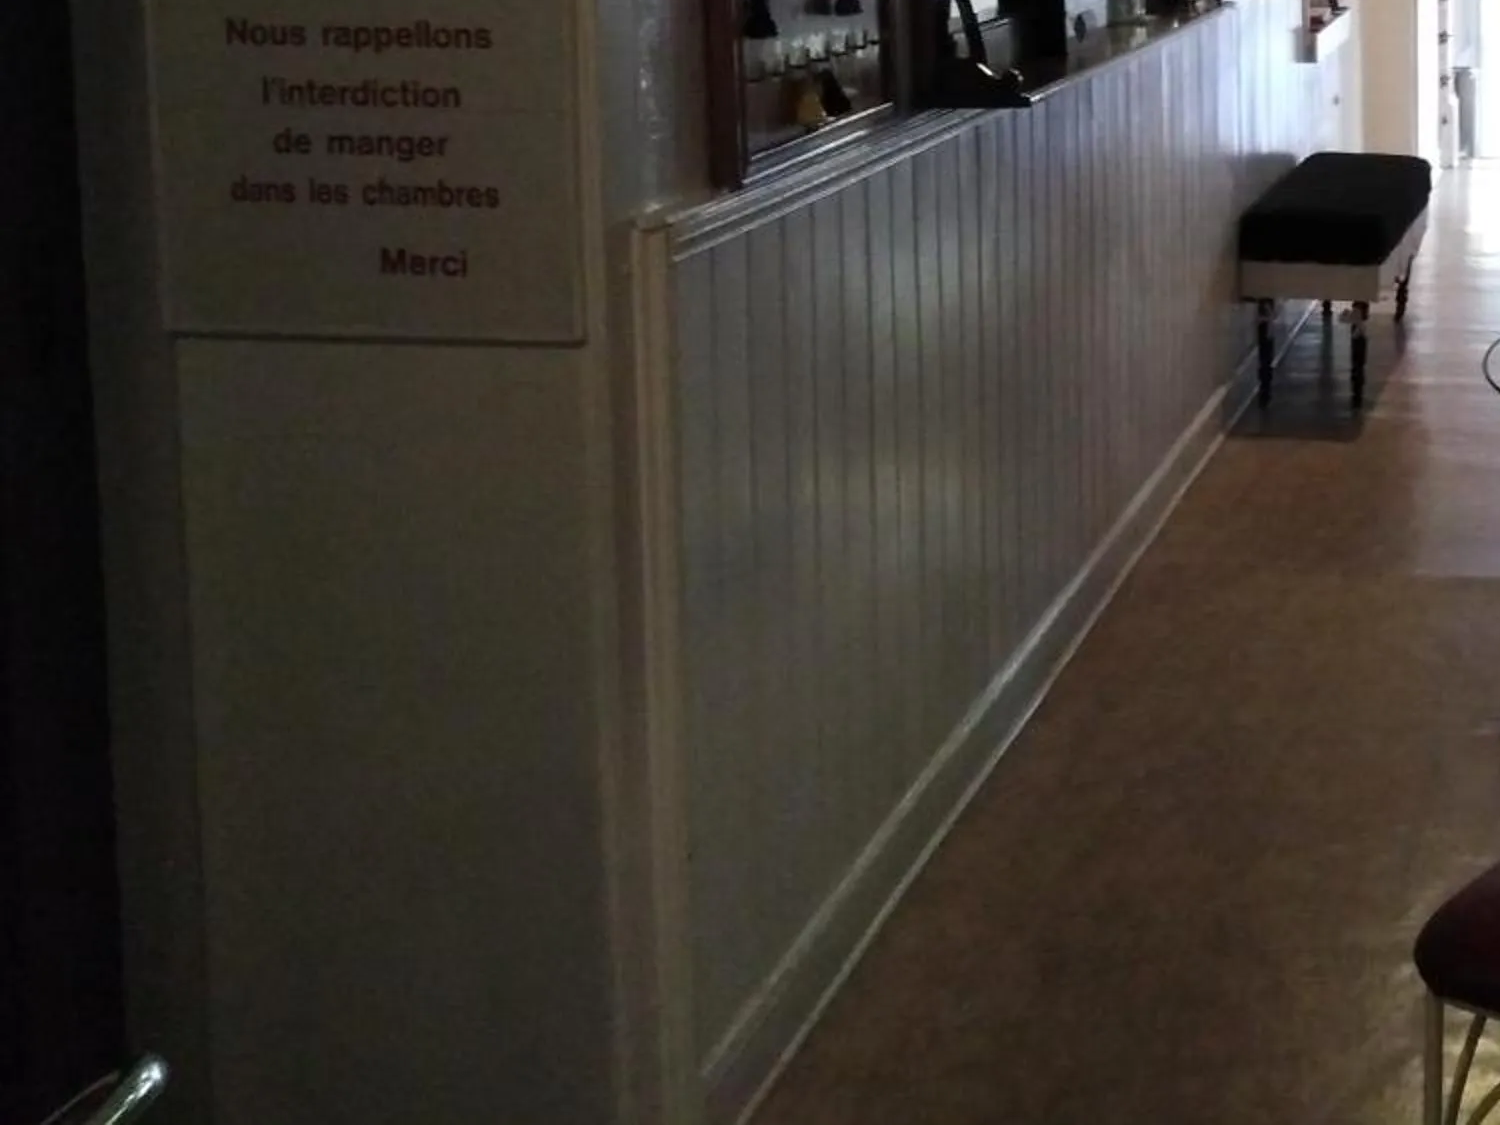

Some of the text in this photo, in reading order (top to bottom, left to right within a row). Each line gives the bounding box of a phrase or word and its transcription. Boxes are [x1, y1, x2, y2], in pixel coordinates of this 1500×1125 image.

[224, 16, 494, 55] Nous rappellons
[261, 75, 462, 109] l'interdiction
[271, 126, 449, 163] de manger
[230, 174, 500, 210] dans les chambres
[379, 246, 469, 278] Merci
